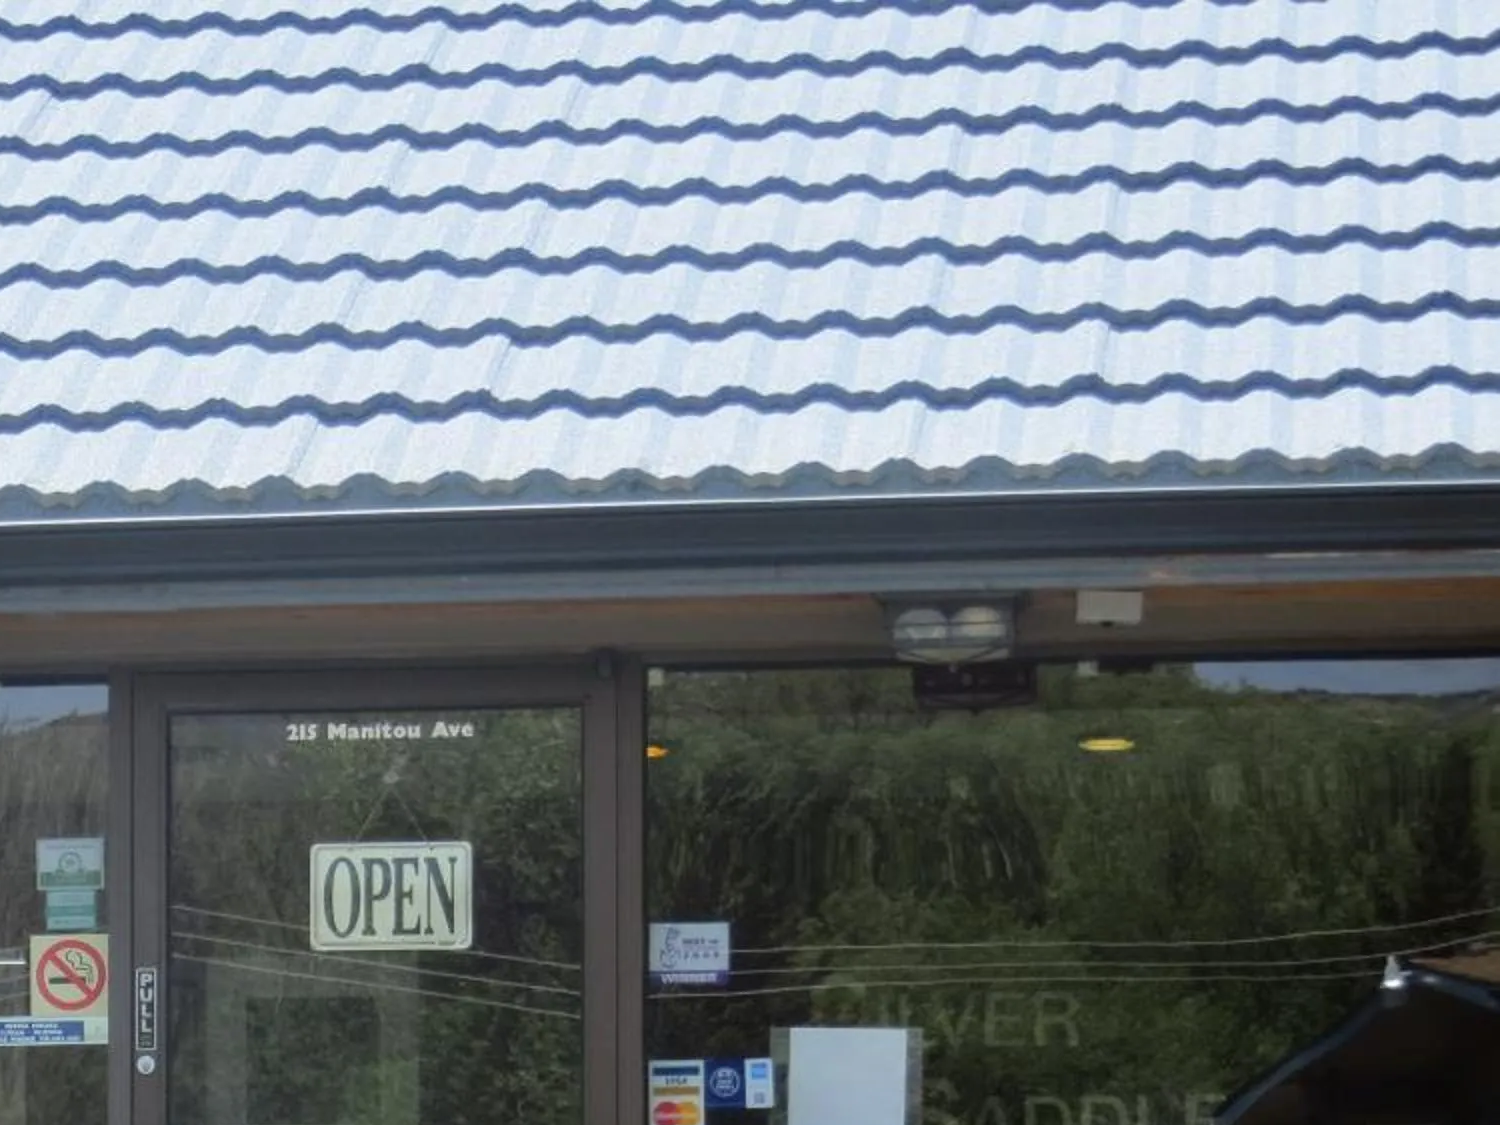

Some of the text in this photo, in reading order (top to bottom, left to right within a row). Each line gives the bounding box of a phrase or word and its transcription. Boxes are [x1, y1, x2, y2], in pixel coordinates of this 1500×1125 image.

[286, 721, 474, 741] 215 Manitou Ave
[322, 856, 458, 938] OPEN
[140, 973, 153, 1033] PULL
